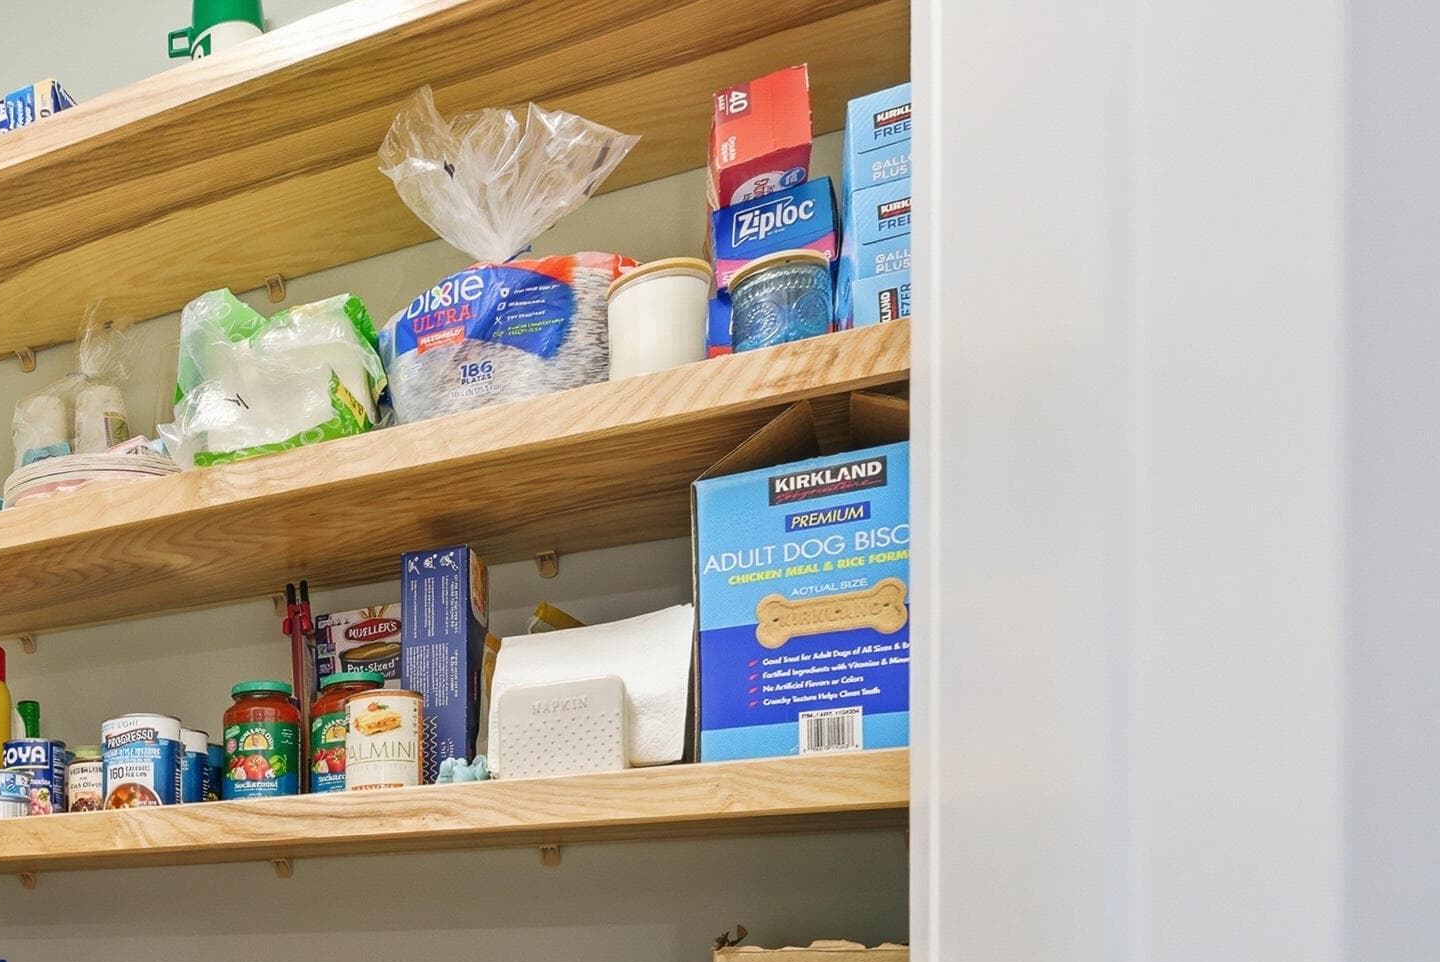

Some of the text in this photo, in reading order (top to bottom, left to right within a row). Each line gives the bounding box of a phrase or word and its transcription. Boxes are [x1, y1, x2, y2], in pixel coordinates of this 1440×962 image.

[728, 90, 748, 114] 40
[872, 164, 908, 182] PLUS
[737, 199, 815, 241] Ziploc
[413, 304, 475, 334] ULTRA
[461, 360, 494, 378] 186
[461, 372, 492, 385] PLATES
[775, 461, 883, 493] KIRKLAND
[791, 505, 864, 529] PREMIUM
[704, 545, 776, 575] ADULT
[784, 535, 846, 563] DOG
[728, 550, 910, 586] CHICKEN MEAL & RICE FORM
[791, 577, 868, 597] ACTUAL SIZE
[349, 621, 397, 639] MUELLER'S
[531, 696, 589, 716] NAPKIN
[107, 729, 155, 749] PROGRESSO
